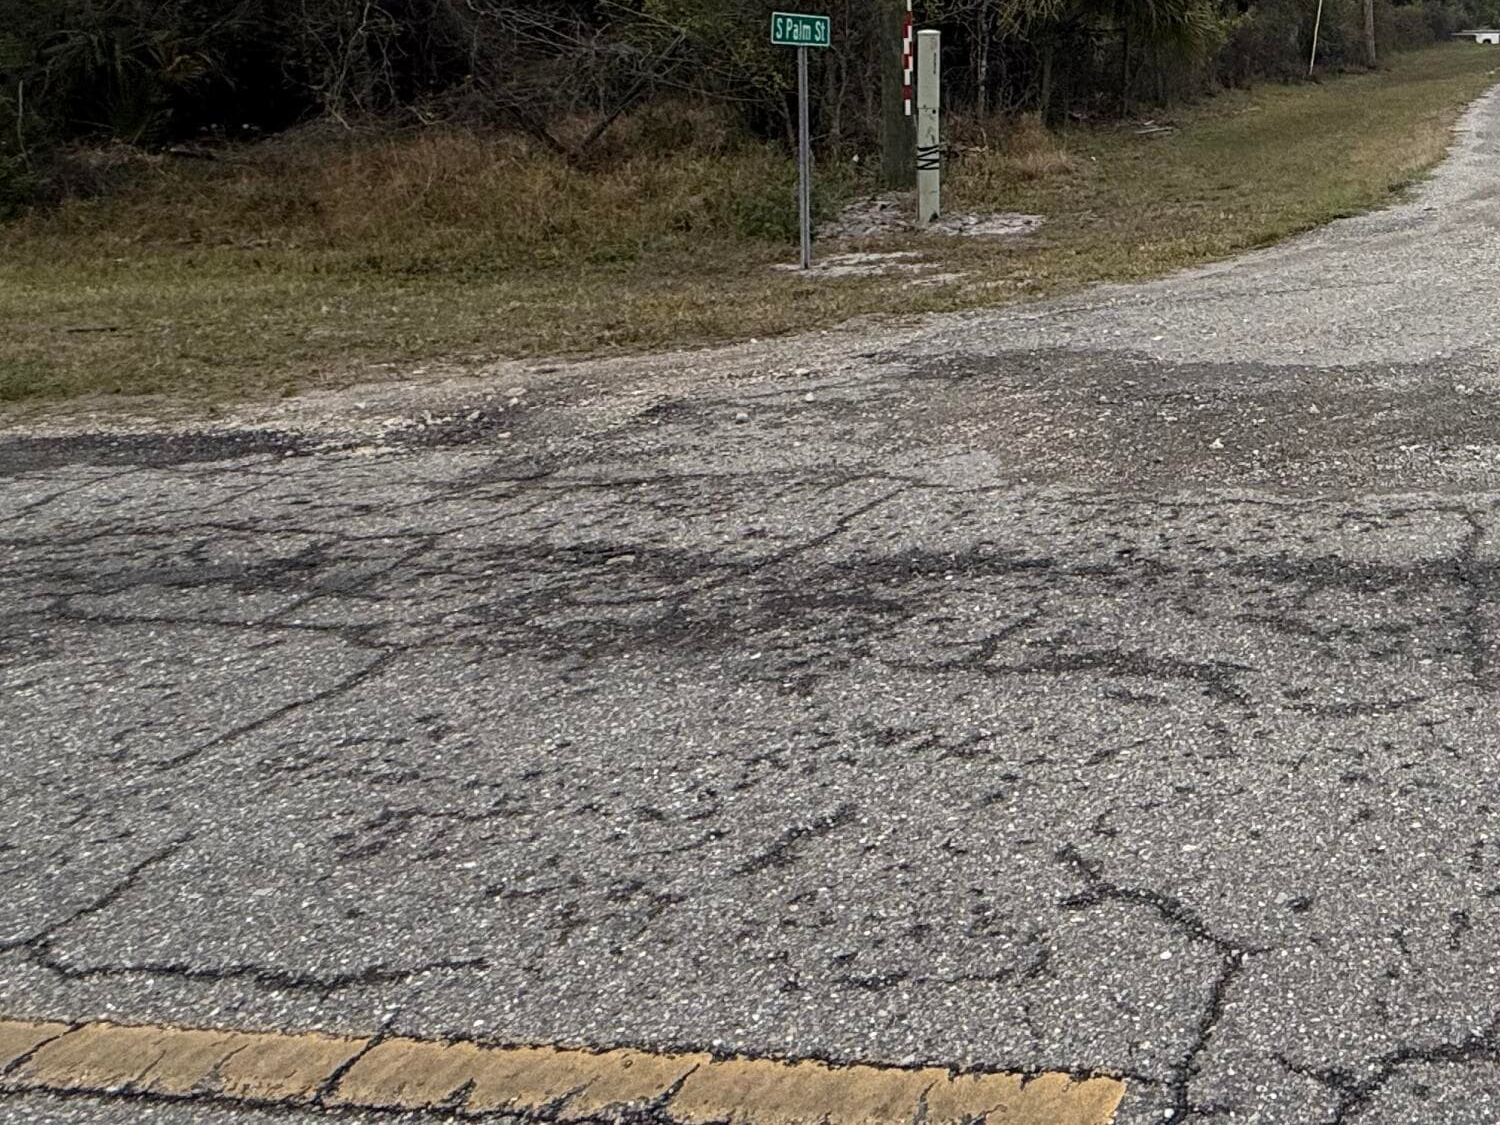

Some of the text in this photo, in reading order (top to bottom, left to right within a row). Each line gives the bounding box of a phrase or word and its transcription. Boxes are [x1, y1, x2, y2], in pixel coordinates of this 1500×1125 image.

[776, 18, 825, 42] S Palm St
